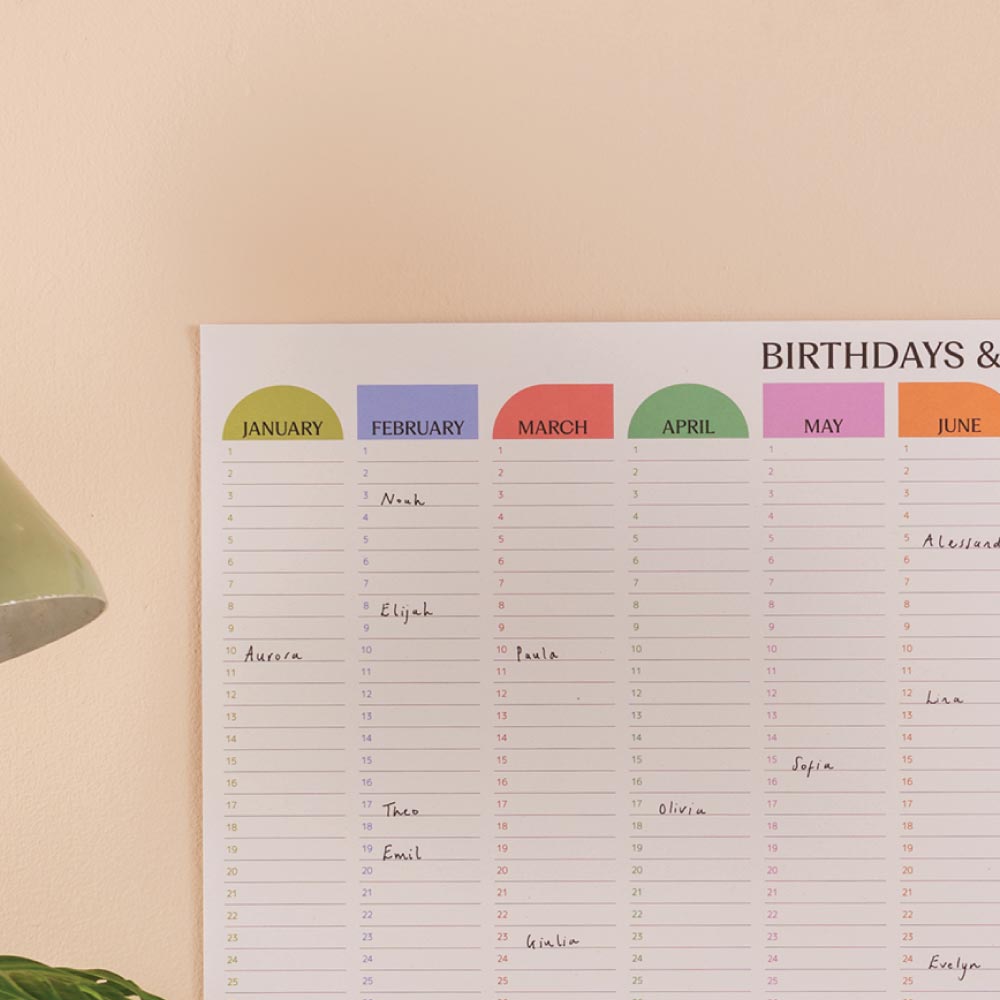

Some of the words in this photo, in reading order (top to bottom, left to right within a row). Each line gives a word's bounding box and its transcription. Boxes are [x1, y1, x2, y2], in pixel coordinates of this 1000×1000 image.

[762, 340, 965, 370] BIRTHDAYS
[242, 421, 323, 439] JANUARY
[372, 420, 465, 436] FEBRUARY
[518, 419, 588, 435] MARCH
[662, 419, 716, 435] APRIL
[804, 418, 844, 434] MAY
[937, 417, 982, 436] JUNE
[363, 490, 369, 500] 3
[380, 492, 425, 506] Noah
[903, 532, 910, 543] 5
[363, 601, 370, 610] 8
[380, 601, 433, 625] Elijah
[225, 646, 237, 655] 10
[244, 645, 302, 663] Aurora
[496, 644, 508, 654] 10
[516, 645, 558, 662] Paula
[902, 688, 913, 697] 12
[767, 755, 778, 764] 15
[791, 756, 834, 778] Sofia
[361, 800, 373, 809] 17
[383, 801, 419, 817] Theo
[631, 799, 643, 808] 17
[658, 801, 706, 816] Olivia
[362, 844, 373, 853] 19
[382, 844, 422, 862] Emil
[497, 932, 509, 942] 23
[902, 954, 913, 963] 24
[928, 954, 981, 981] Evelyn
